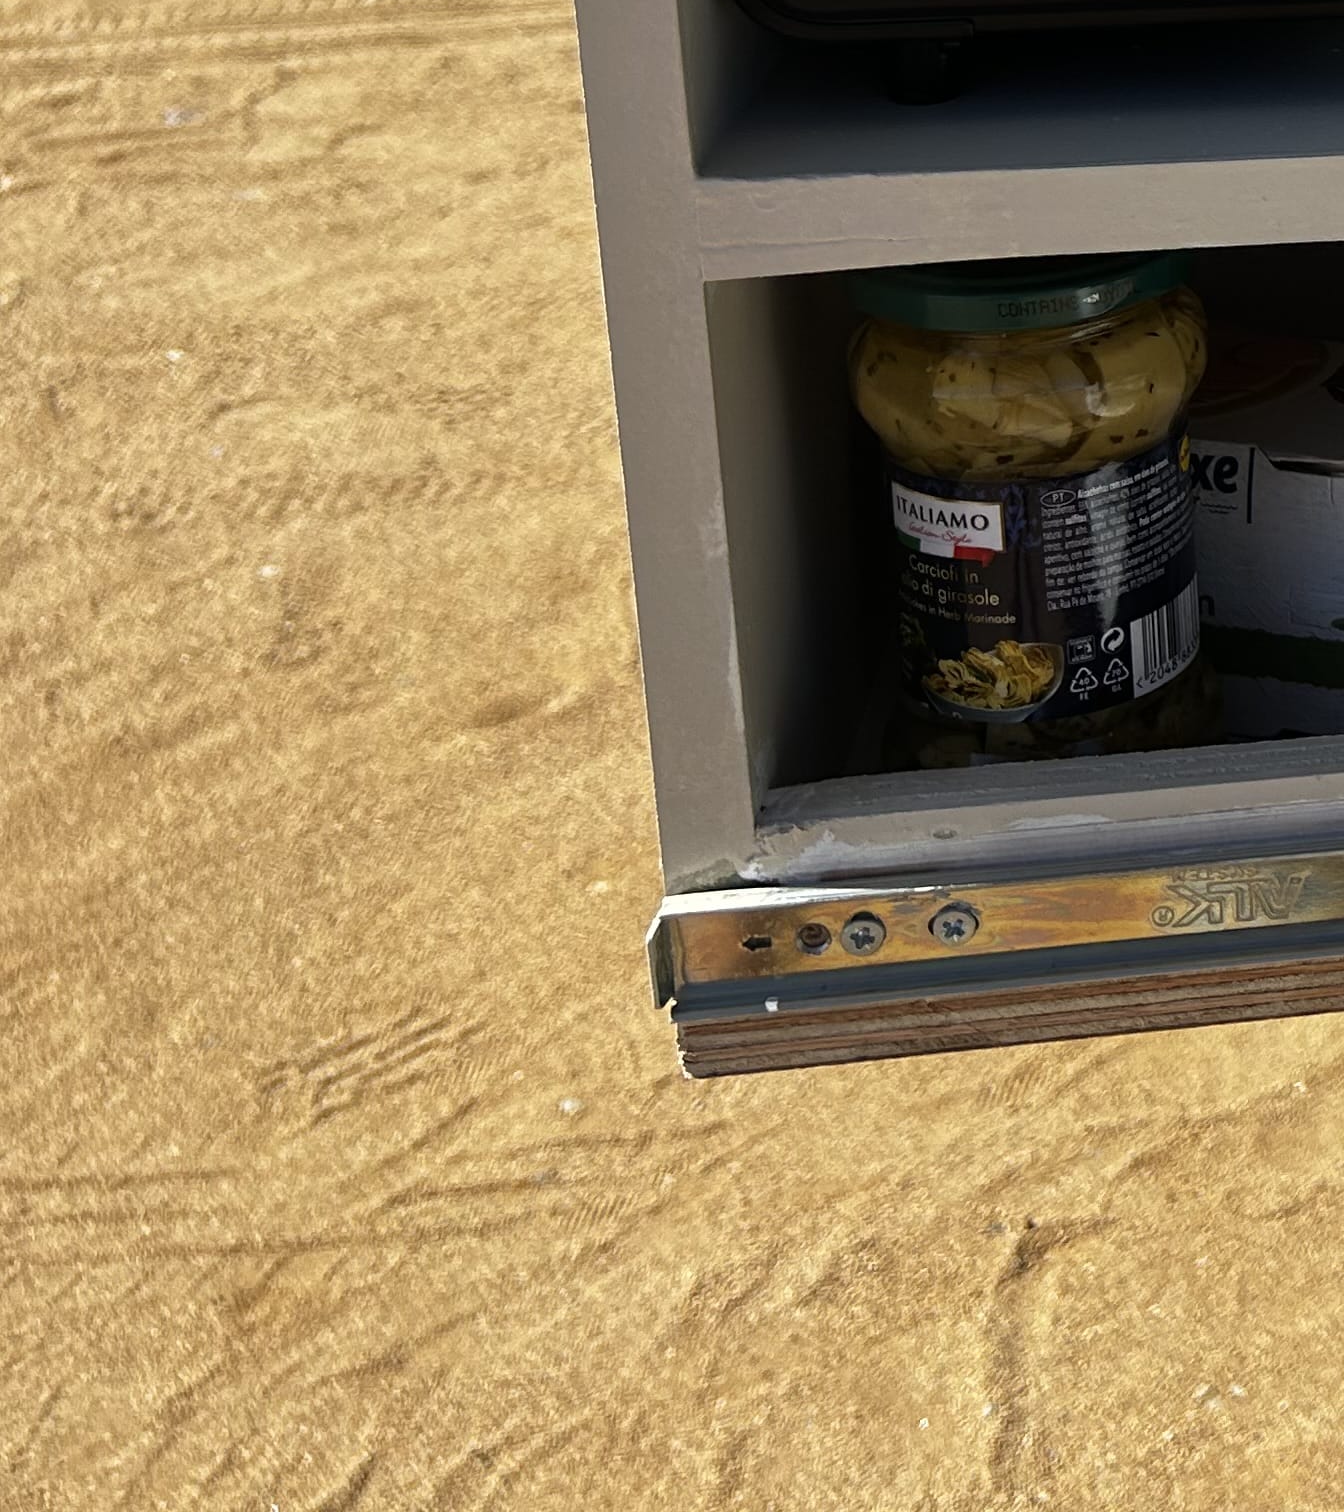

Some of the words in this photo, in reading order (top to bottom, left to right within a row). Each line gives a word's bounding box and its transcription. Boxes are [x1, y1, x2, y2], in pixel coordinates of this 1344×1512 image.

[1190, 452, 1239, 494] xe
[896, 495, 990, 532] ITALIAMO
[937, 588, 1001, 608] girasole
